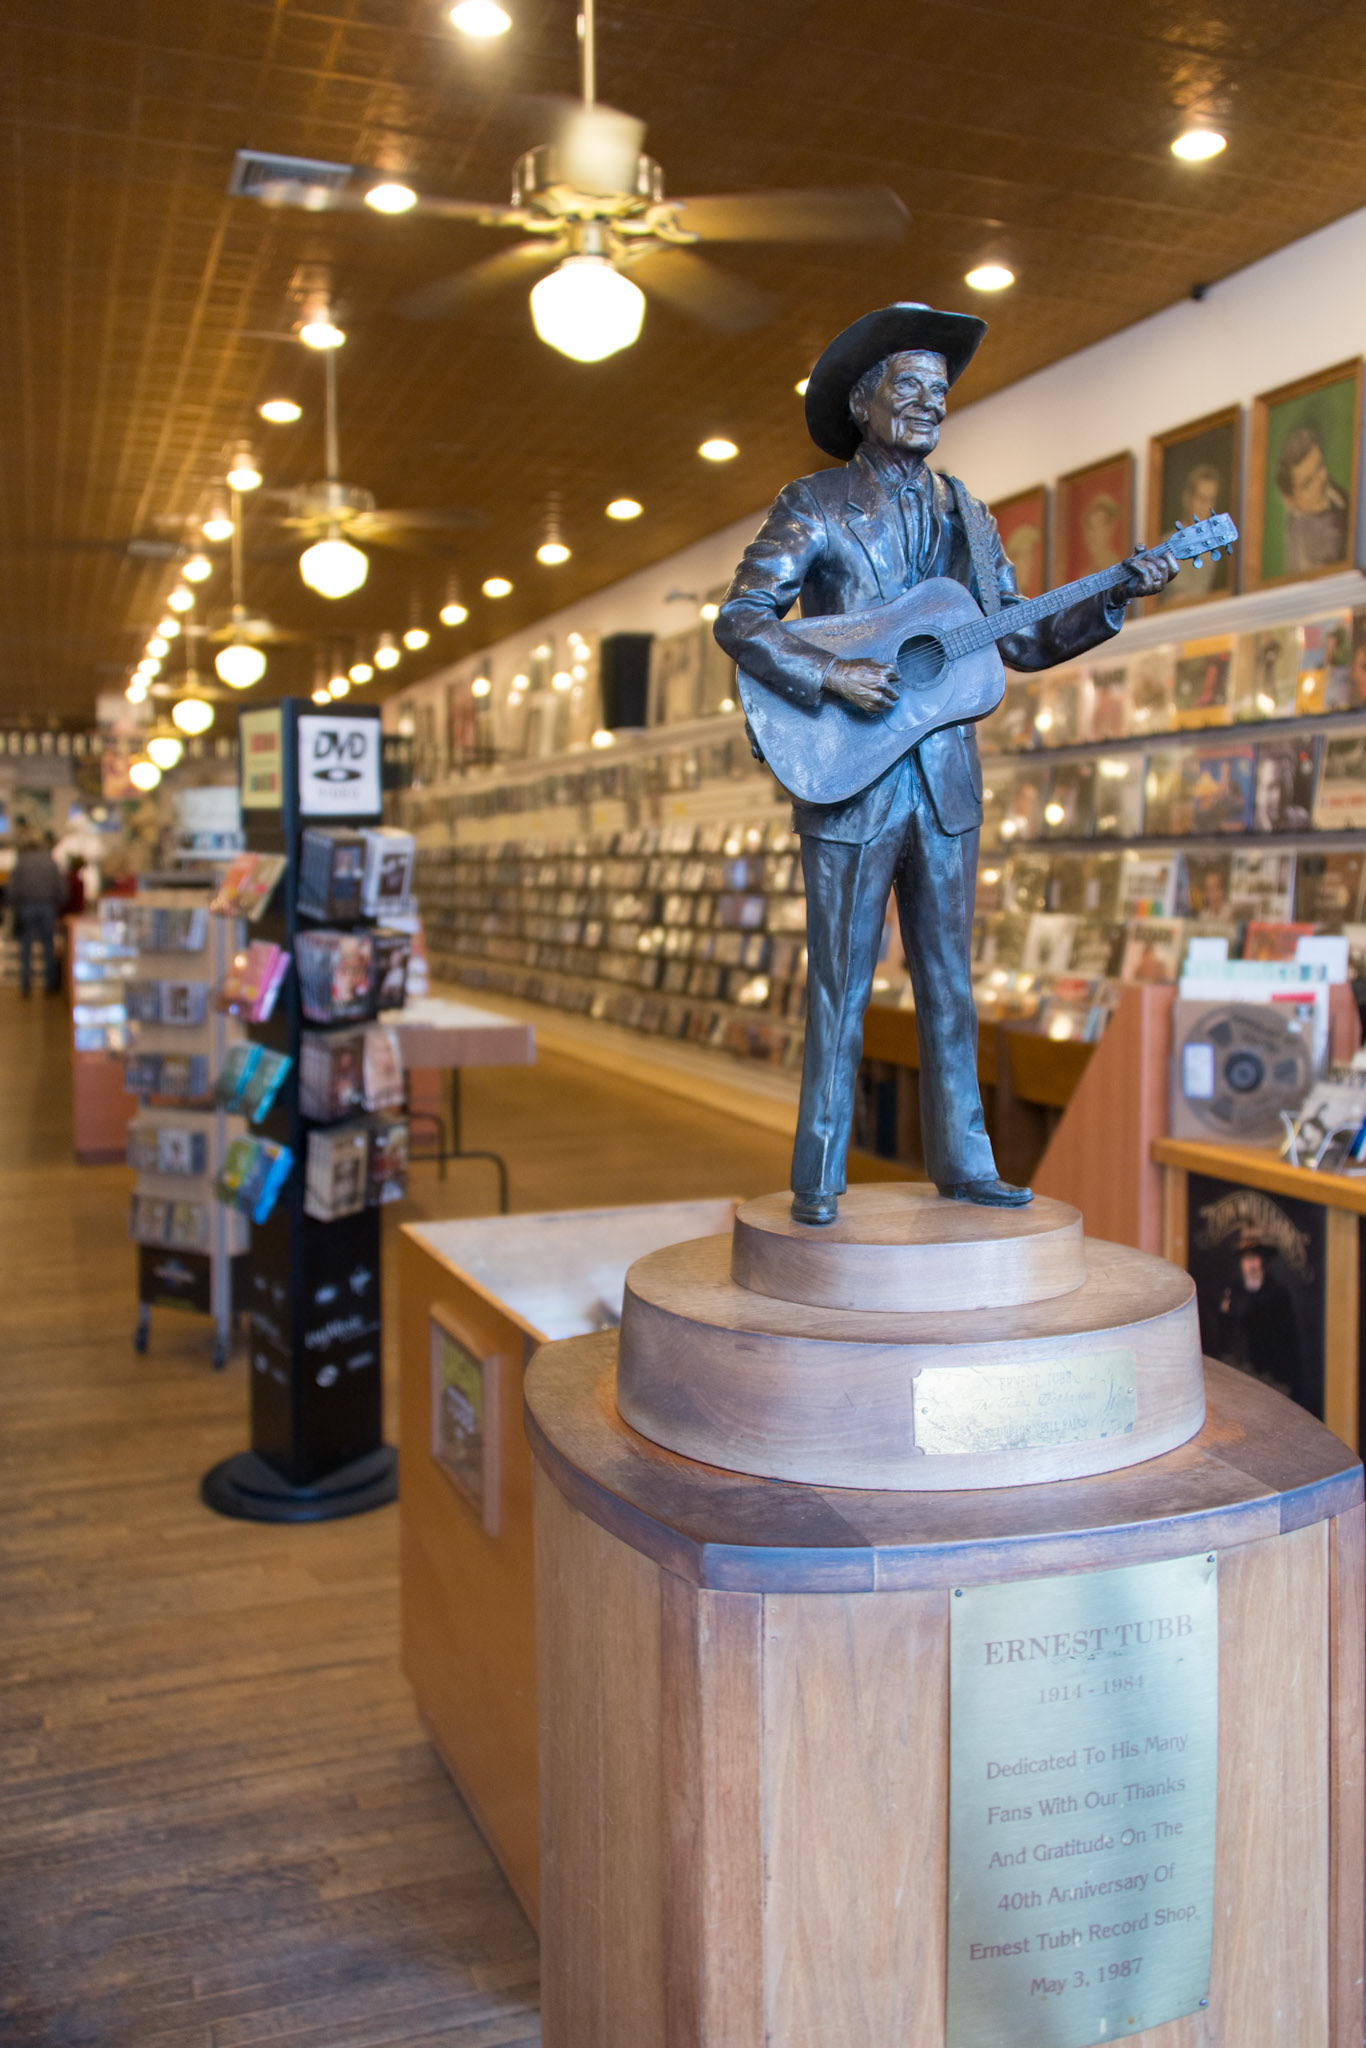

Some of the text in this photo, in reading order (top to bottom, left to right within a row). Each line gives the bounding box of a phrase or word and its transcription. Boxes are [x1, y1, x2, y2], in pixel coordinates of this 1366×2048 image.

[314, 731, 366, 760] DVD
[983, 1613, 1193, 1665] ERNEST TUBB
[1039, 1683, 1082, 1705] 1914
[1103, 1674, 1145, 1696] 1984
[986, 1733, 1189, 1780] Dedicated To His Many
[987, 1777, 1186, 1825] Fans With Our Thanks
[987, 1820, 1184, 1870] And Gratitude On The
[997, 1862, 1177, 1912] 40th Anniversary Of
[968, 1936, 1030, 1961] Ernest
[1036, 1928, 1083, 1952] Tubb
[1089, 1912, 1149, 1943] Record
[1030, 1976, 1067, 1997] May
[1097, 1956, 1143, 1984] 1987
